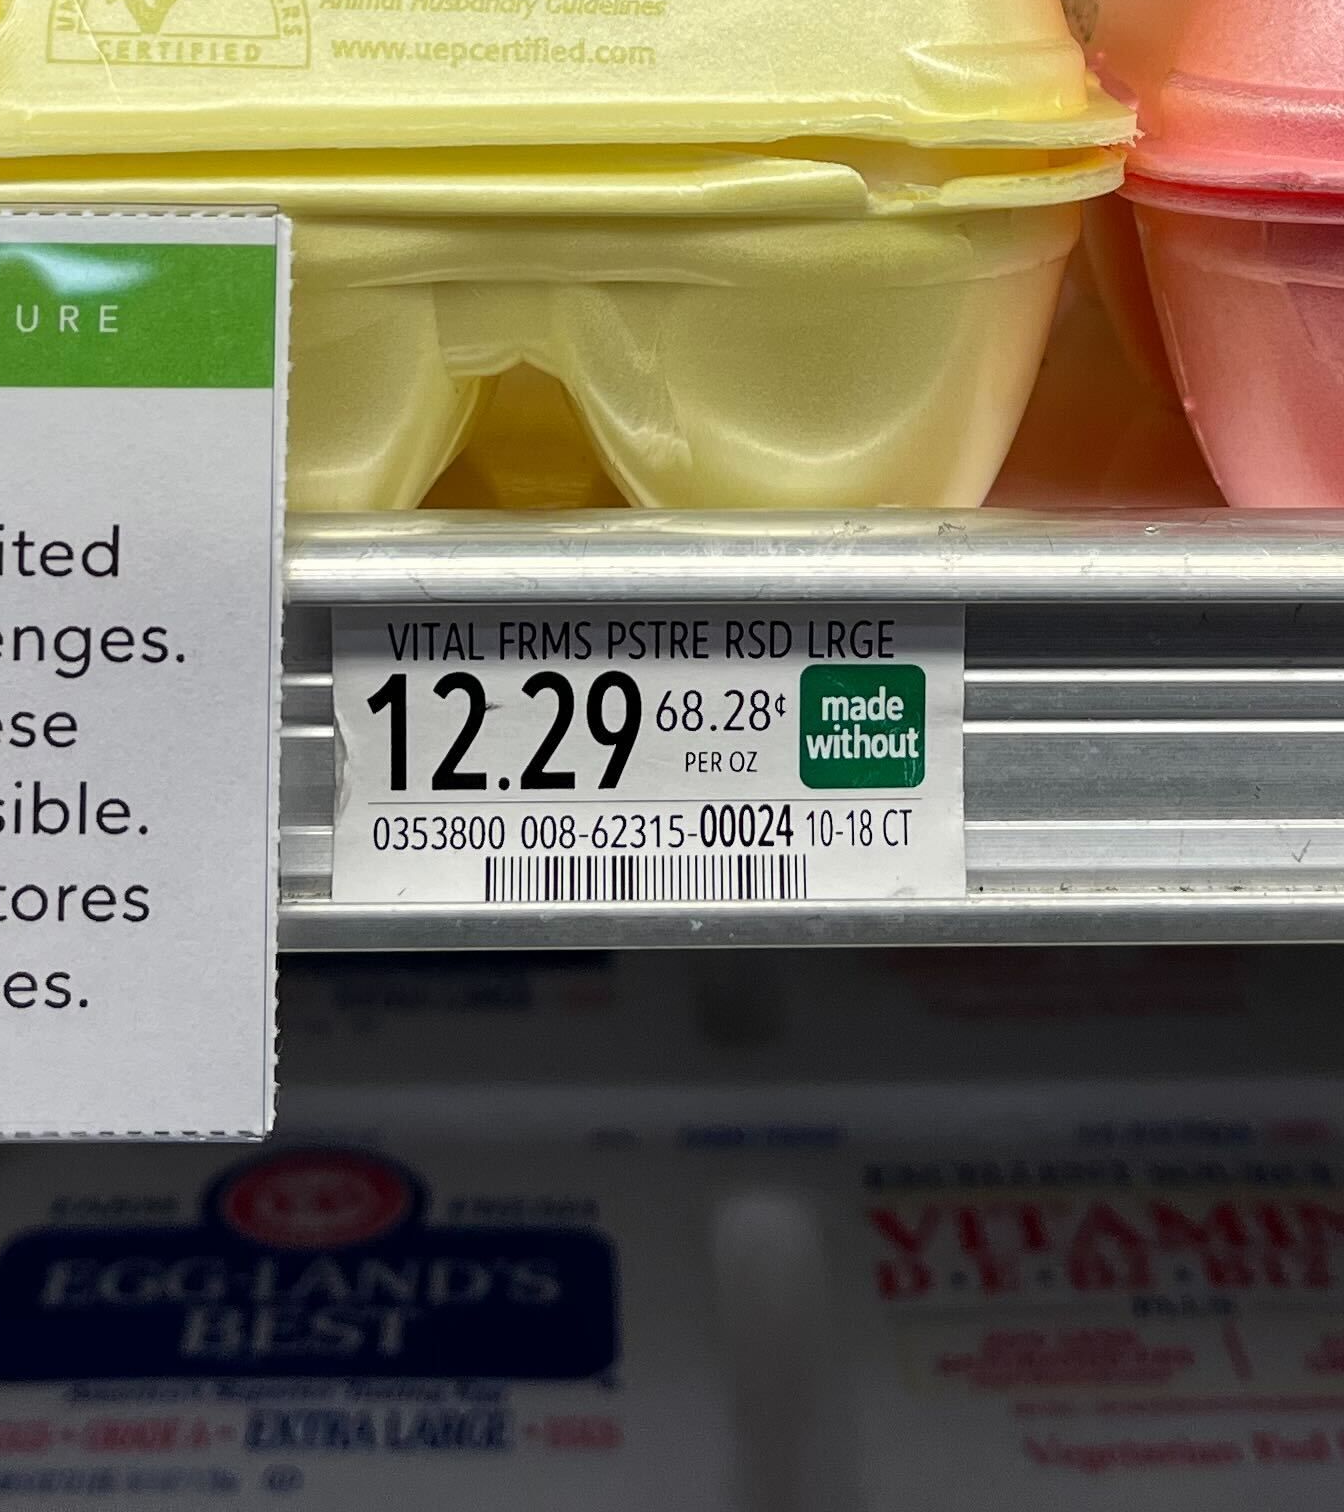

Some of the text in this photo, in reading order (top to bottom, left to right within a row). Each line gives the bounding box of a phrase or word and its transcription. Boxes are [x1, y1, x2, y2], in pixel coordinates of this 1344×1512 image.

[98, 39, 263, 63] CERTIFIED
[331, 37, 656, 68] www.uepcertified.com
[387, 620, 895, 662] VITAL FRMS PSTRE RSD LRGE
[821, 687, 904, 721] made
[367, 671, 642, 790] 12.29
[806, 726, 920, 761] without
[685, 752, 758, 773] PER OZ
[373, 804, 913, 849] 0353800 008-62315-00024 10-18 CT
[178, 1307, 419, 1360] BEST
